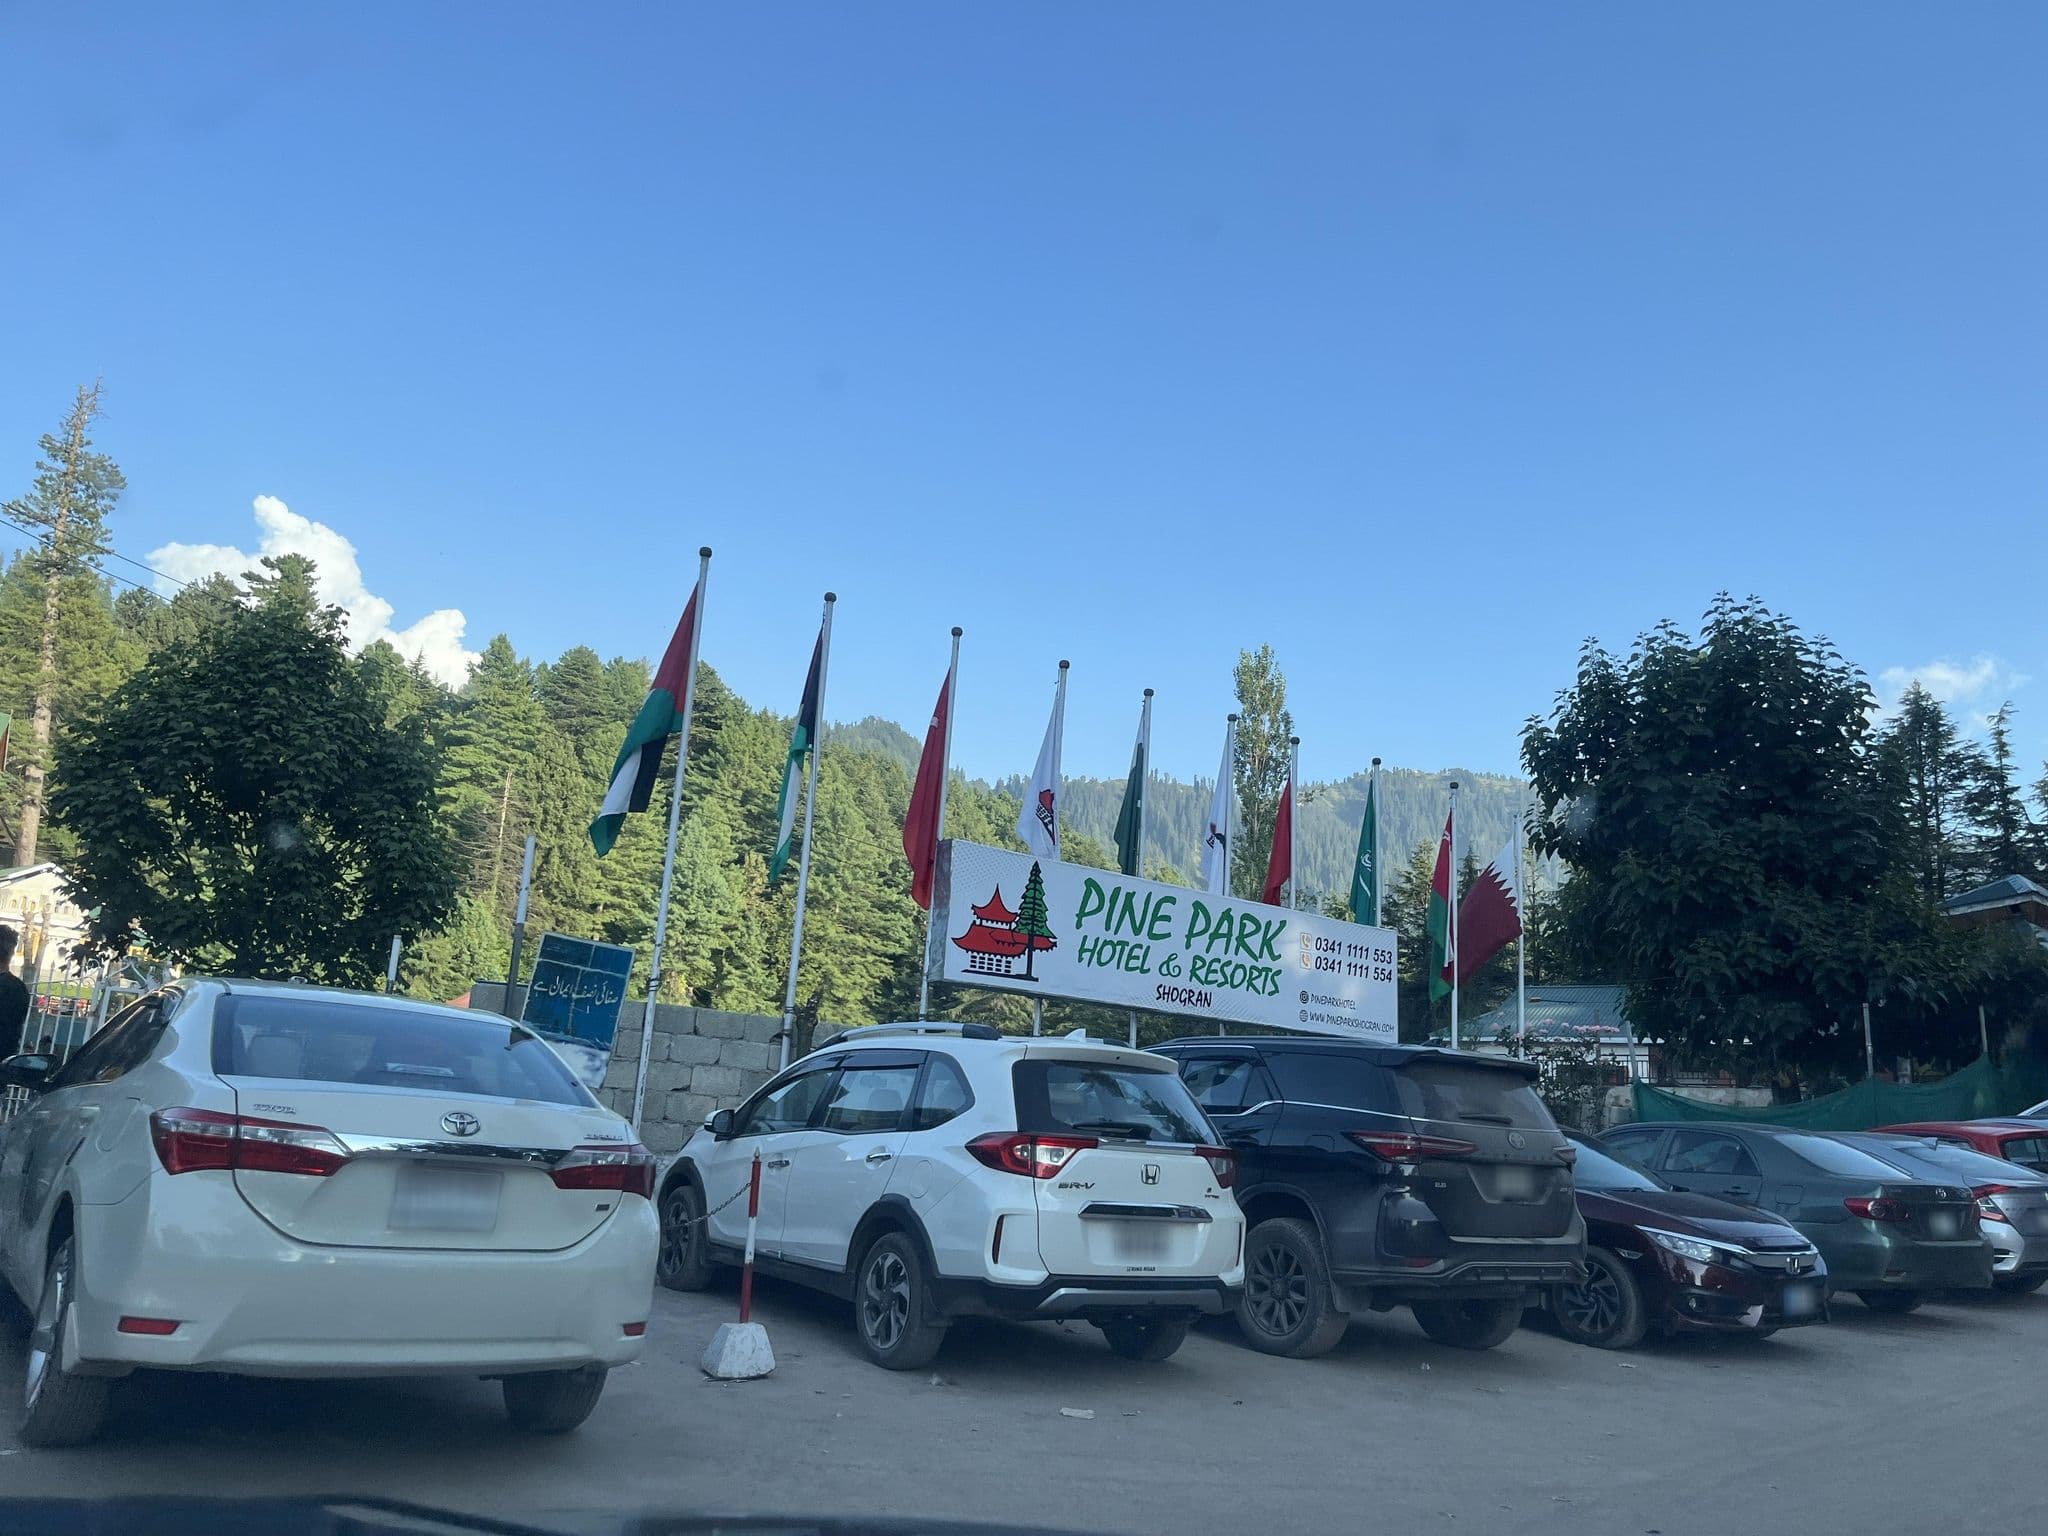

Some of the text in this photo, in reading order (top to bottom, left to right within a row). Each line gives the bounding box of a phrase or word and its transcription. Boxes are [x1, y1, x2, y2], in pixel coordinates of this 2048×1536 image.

[1075, 877, 1287, 962] PINE PARK
[1315, 937, 1393, 964] 0341 1111 553
[1078, 935, 1282, 996] HOTEL & RESORTS
[1315, 956, 1393, 983] 0341 1111 554
[548, 975, 573, 998] ایمان
[571, 984, 598, 999] نصف
[1156, 984, 1212, 1007] SHOGRAN
[253, 1103, 296, 1115] TOYOTA
